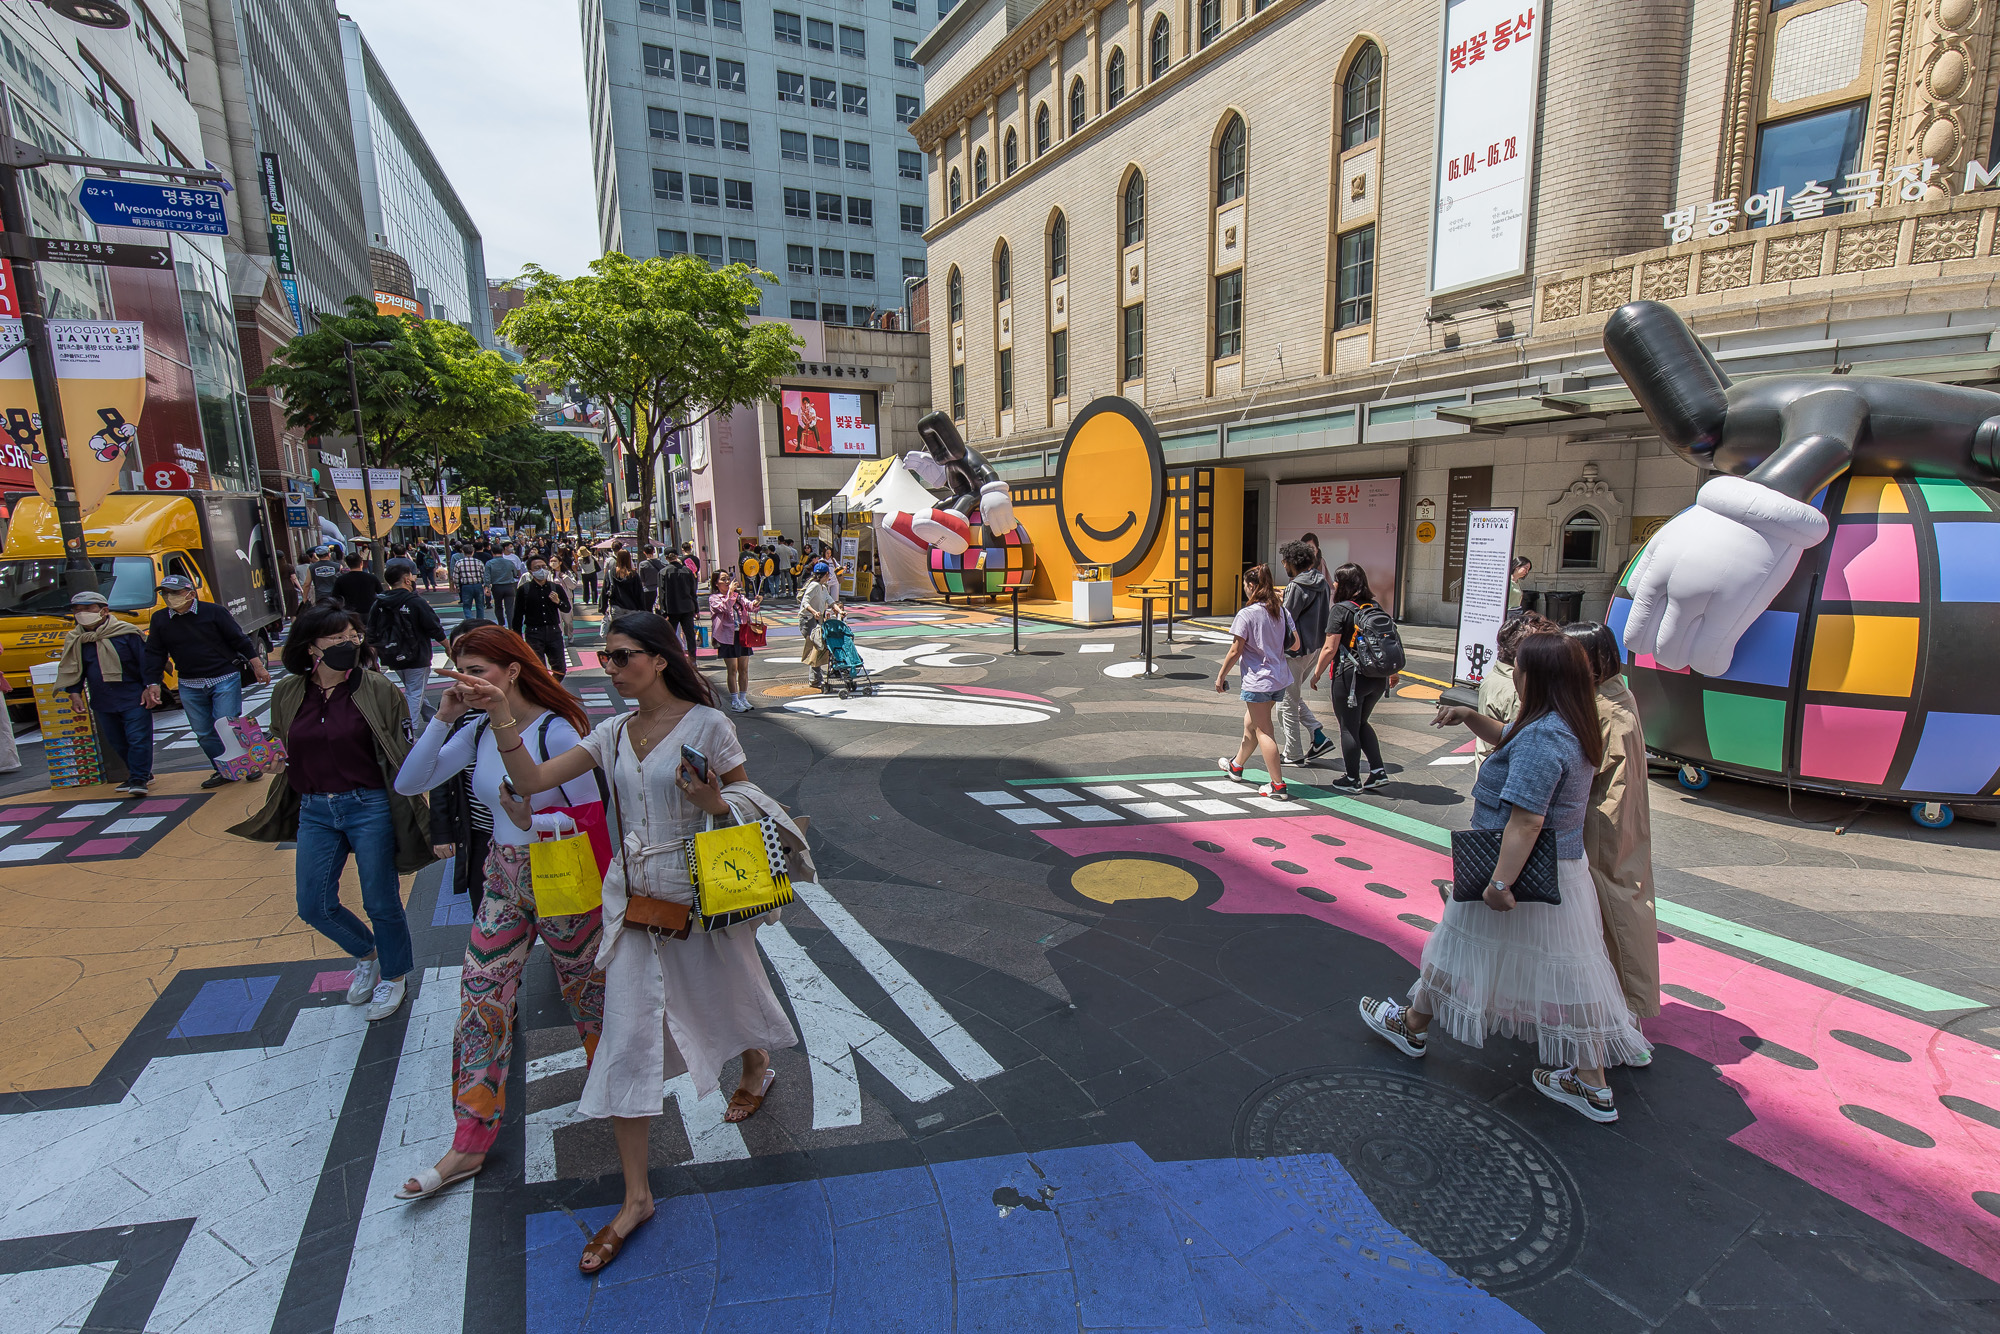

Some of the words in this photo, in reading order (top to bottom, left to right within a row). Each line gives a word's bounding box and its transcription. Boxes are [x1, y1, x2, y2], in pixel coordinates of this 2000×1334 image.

[1449, 30, 1487, 74] 벚꽃
[1492, 7, 1536, 52] 동산
[87, 187, 99, 196] 62
[109, 189, 114, 197] 1
[162, 189, 220, 209] 명동8길
[1662, 157, 1940, 243] 명동예술극장
[114, 202, 193, 220] Myeongdong
[195, 211, 222, 222] 8-gil
[271, 215, 287, 223] 치과
[132, 218, 165, 228] 明洞8街
[276, 225, 291, 271] 연세미소래
[375, 292, 403, 308] 라거의
[403, 298, 417, 313] 반전
[796, 363, 870, 379] 명동예술극장
[835, 416, 852, 429] 벚꽃
[854, 416, 870, 429] 동
[5, 444, 33, 470] SAL
[1310, 485, 1332, 505] 벚꽃
[1335, 484, 1360, 503] 동산
[730, 846, 758, 864] REPUBLIC
